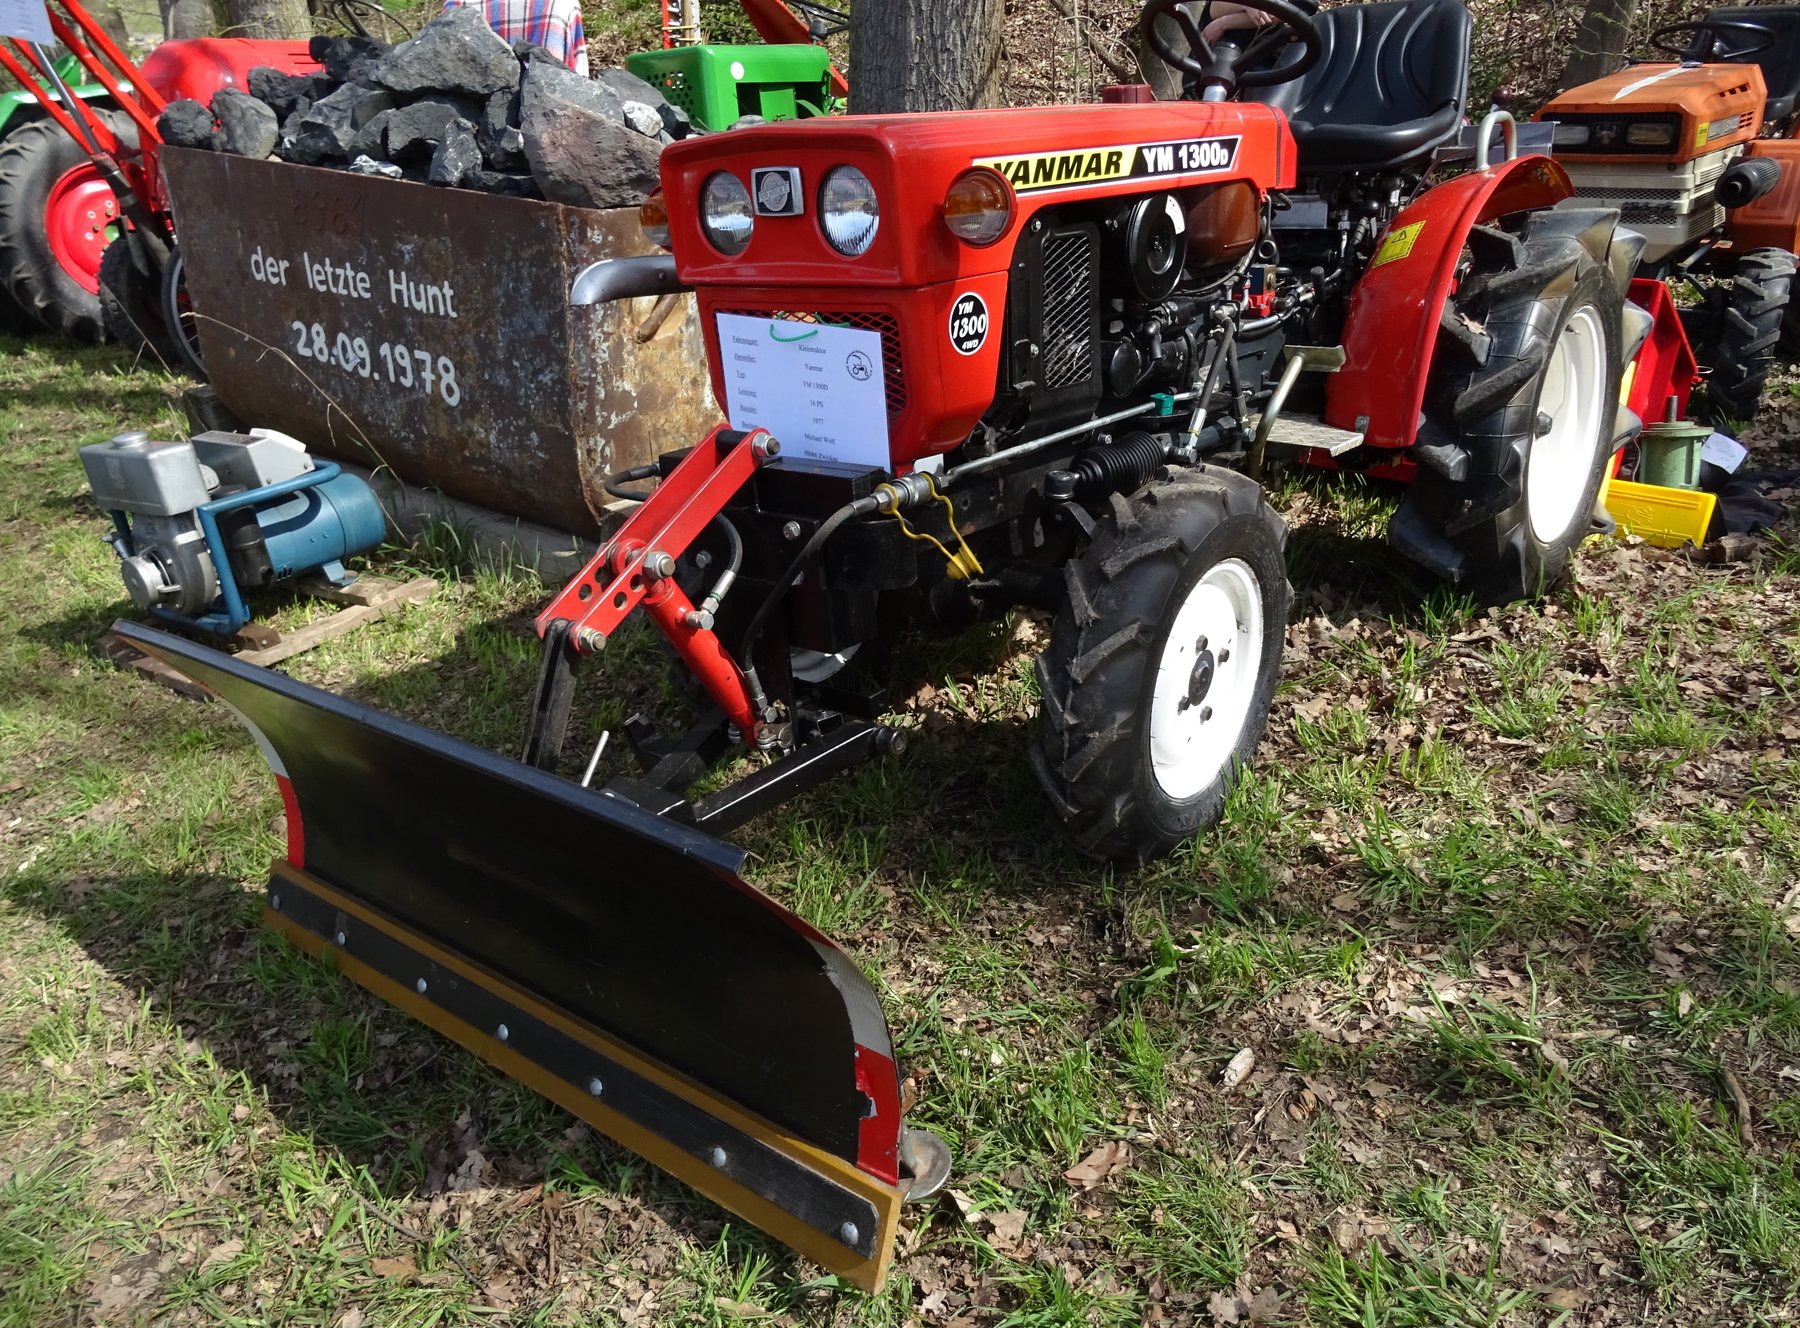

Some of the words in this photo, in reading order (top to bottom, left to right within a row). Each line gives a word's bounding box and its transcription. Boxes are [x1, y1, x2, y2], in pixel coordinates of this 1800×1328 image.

[1141, 145, 1173, 173] YM
[1178, 141, 1229, 169] 1300D
[250, 245, 290, 286] der
[303, 251, 372, 299] letzte
[388, 269, 458, 318] Hunt
[958, 301, 974, 315] YM
[952, 313, 987, 340] 1300
[961, 338, 979, 350] 4WD
[291, 320, 461, 407] 28.09.1978
[812, 416, 824, 425] 1977
